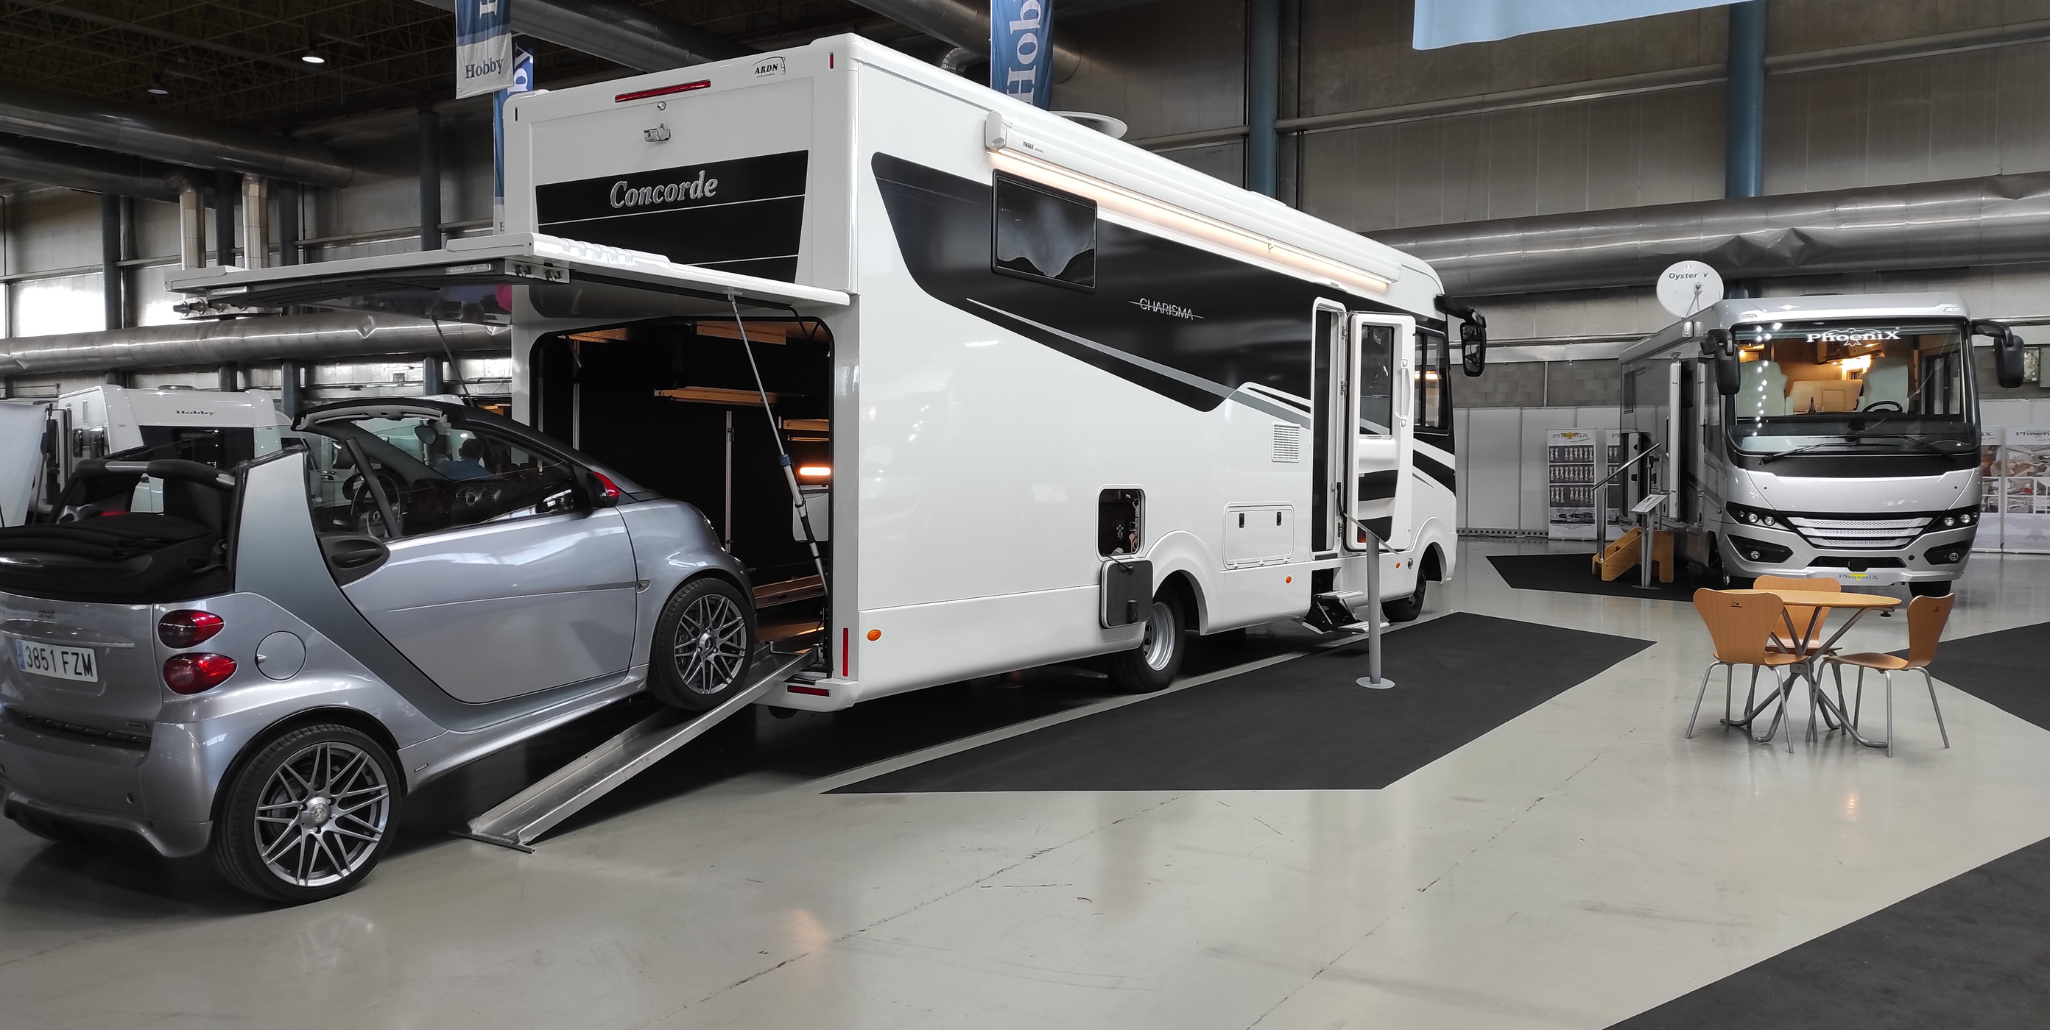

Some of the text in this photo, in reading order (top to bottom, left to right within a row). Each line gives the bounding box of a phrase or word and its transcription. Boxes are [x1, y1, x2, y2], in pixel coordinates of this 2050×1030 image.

[465, 57, 504, 79] Hobby
[609, 170, 719, 209] Concorde
[1668, 272, 1699, 281] Oyster
[1139, 297, 1194, 321] CHARISMA
[25, 646, 93, 677] 3851 FZM
